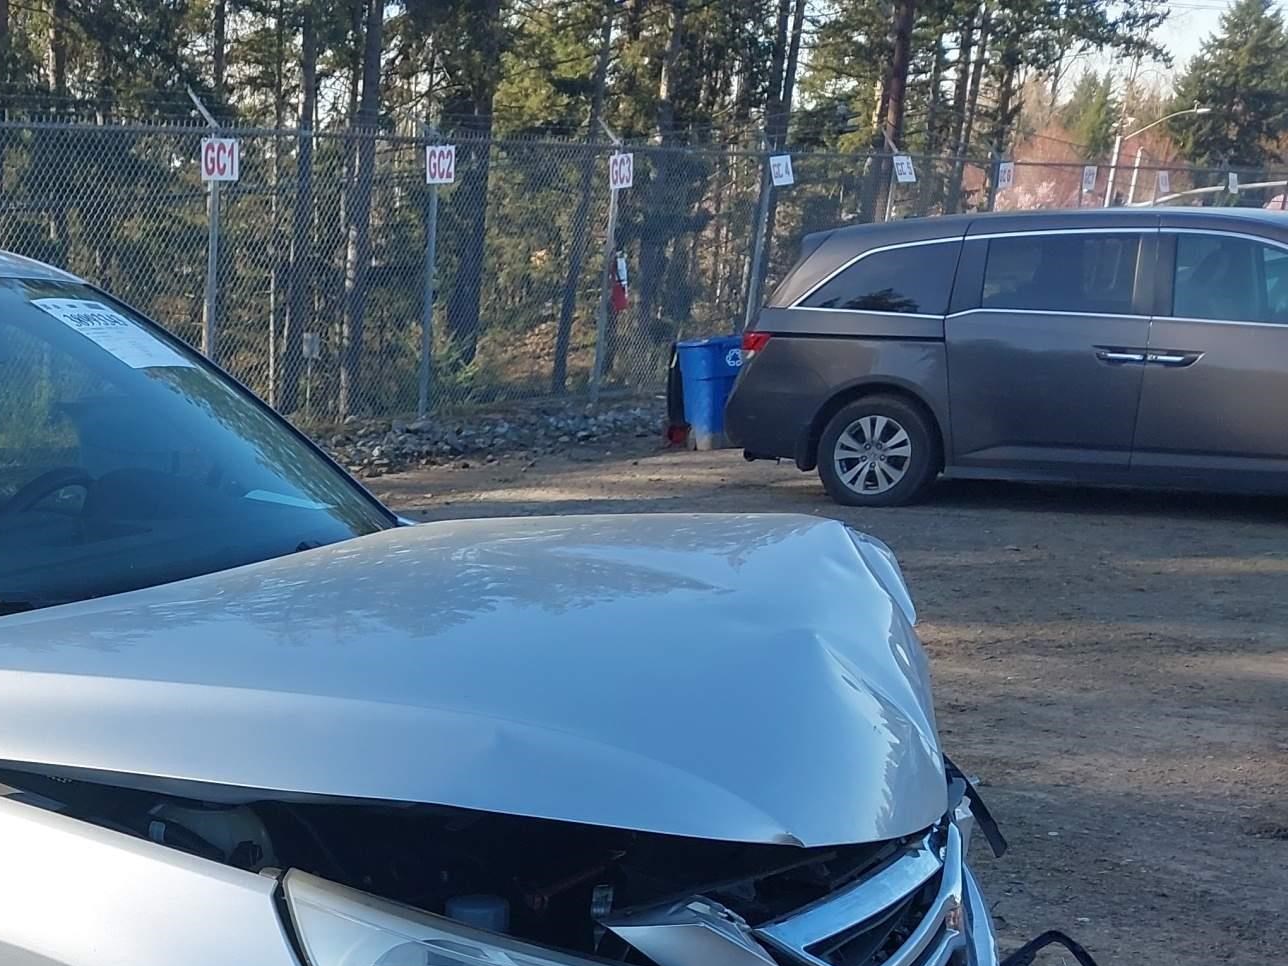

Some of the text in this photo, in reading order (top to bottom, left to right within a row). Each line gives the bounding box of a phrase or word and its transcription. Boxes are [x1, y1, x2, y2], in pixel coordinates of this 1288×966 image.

[204, 142, 235, 177] GC1
[428, 150, 453, 179] GC2
[612, 155, 632, 185] GC3
